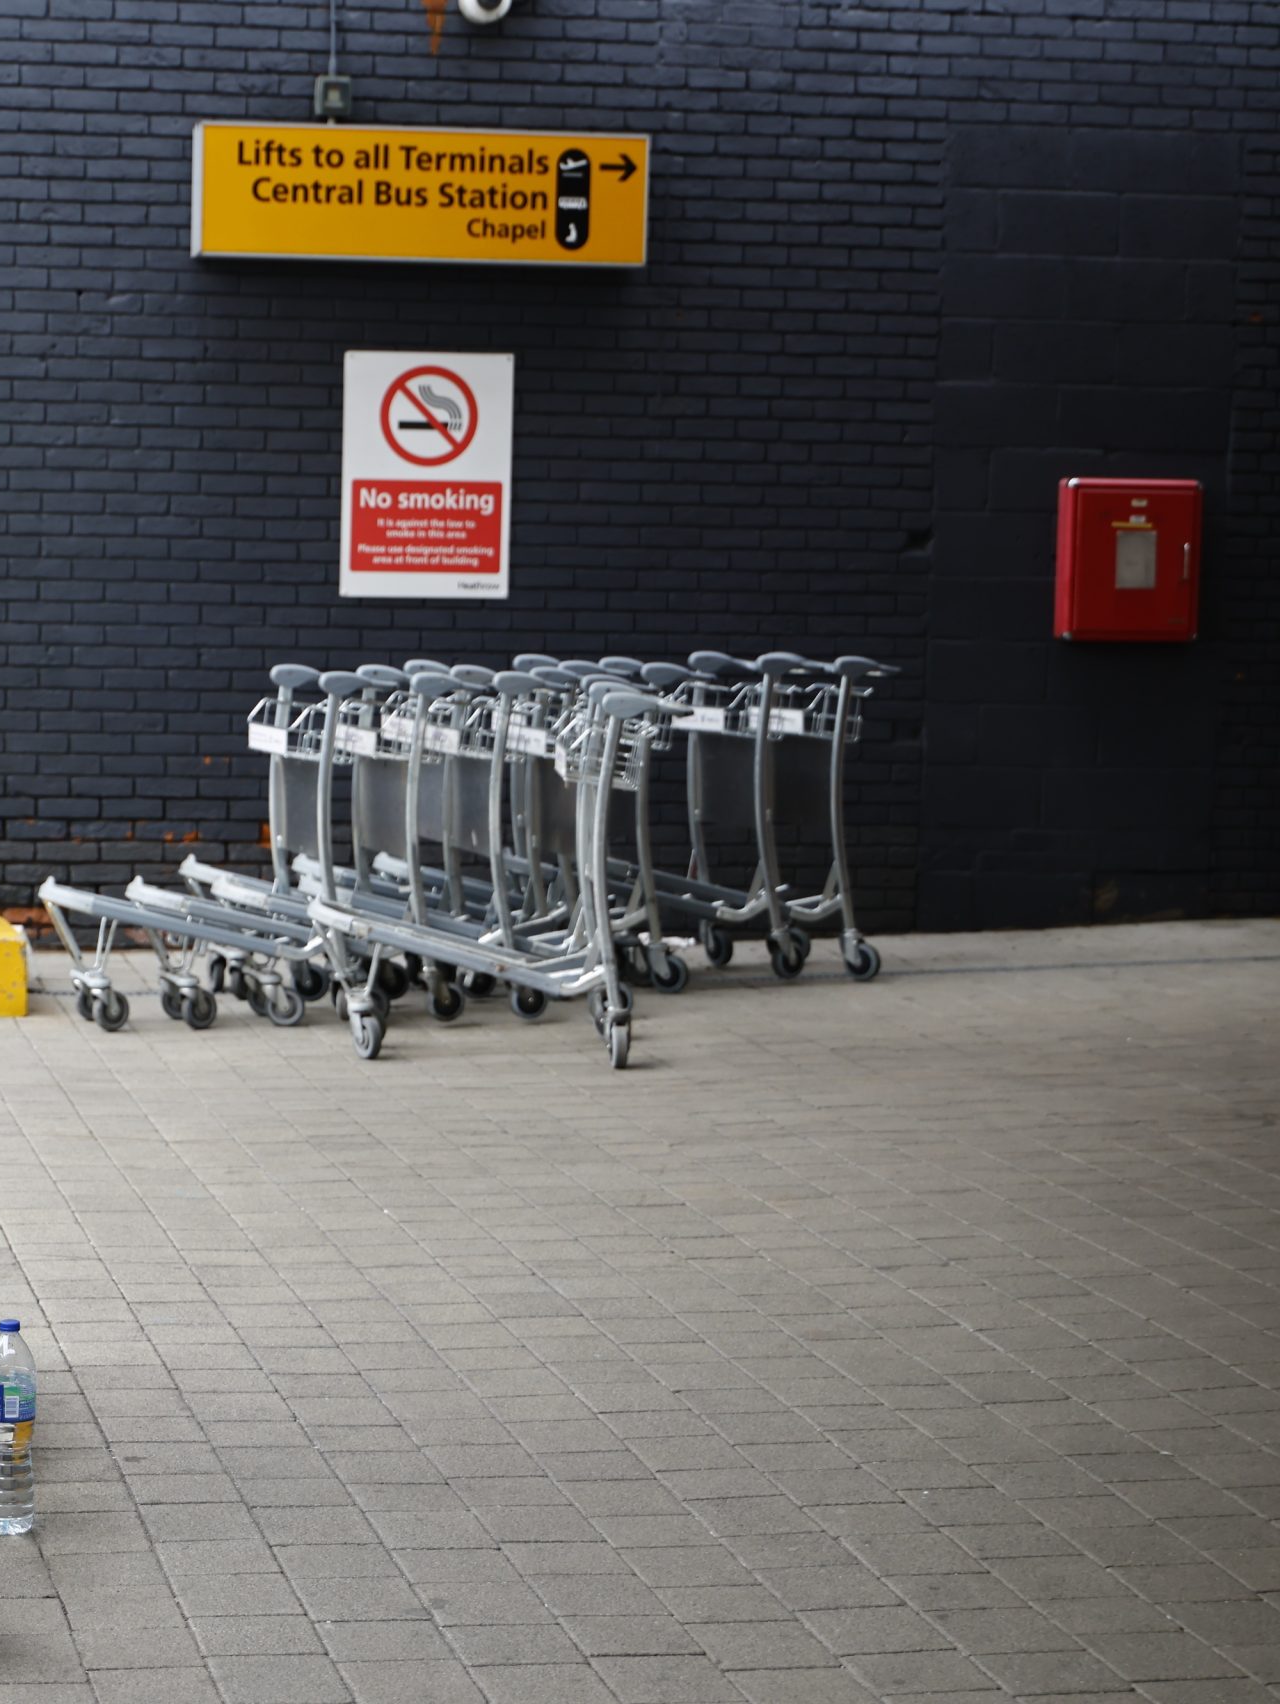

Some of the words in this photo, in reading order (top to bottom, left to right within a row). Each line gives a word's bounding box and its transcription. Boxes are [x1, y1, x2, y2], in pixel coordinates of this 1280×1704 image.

[237, 139, 302, 167] Lifts
[312, 144, 345, 169] to
[353, 144, 389, 170] all
[399, 145, 549, 175] Terminals
[252, 177, 363, 205] Central
[374, 180, 428, 207] Bus
[438, 181, 548, 211] Station
[466, 217, 546, 244] Chapel
[359, 488, 392, 508] No
[398, 488, 495, 516] smoking
[377, 518, 385, 528] It
[395, 519, 428, 530] against
[430, 519, 445, 528] the
[465, 520, 476, 529] to
[386, 529, 415, 538] smoke
[417, 529, 426, 538] in
[428, 530, 444, 538] this
[447, 531, 467, 540] area
[358, 544, 386, 554] Please
[387, 546, 403, 554] use
[405, 545, 454, 556] designated
[455, 546, 495, 558] smoking
[372, 556, 392, 564] area
[393, 556, 404, 564] at
[405, 555, 428, 565] front
[430, 556, 440, 565] of
[442, 556, 479, 568] building
